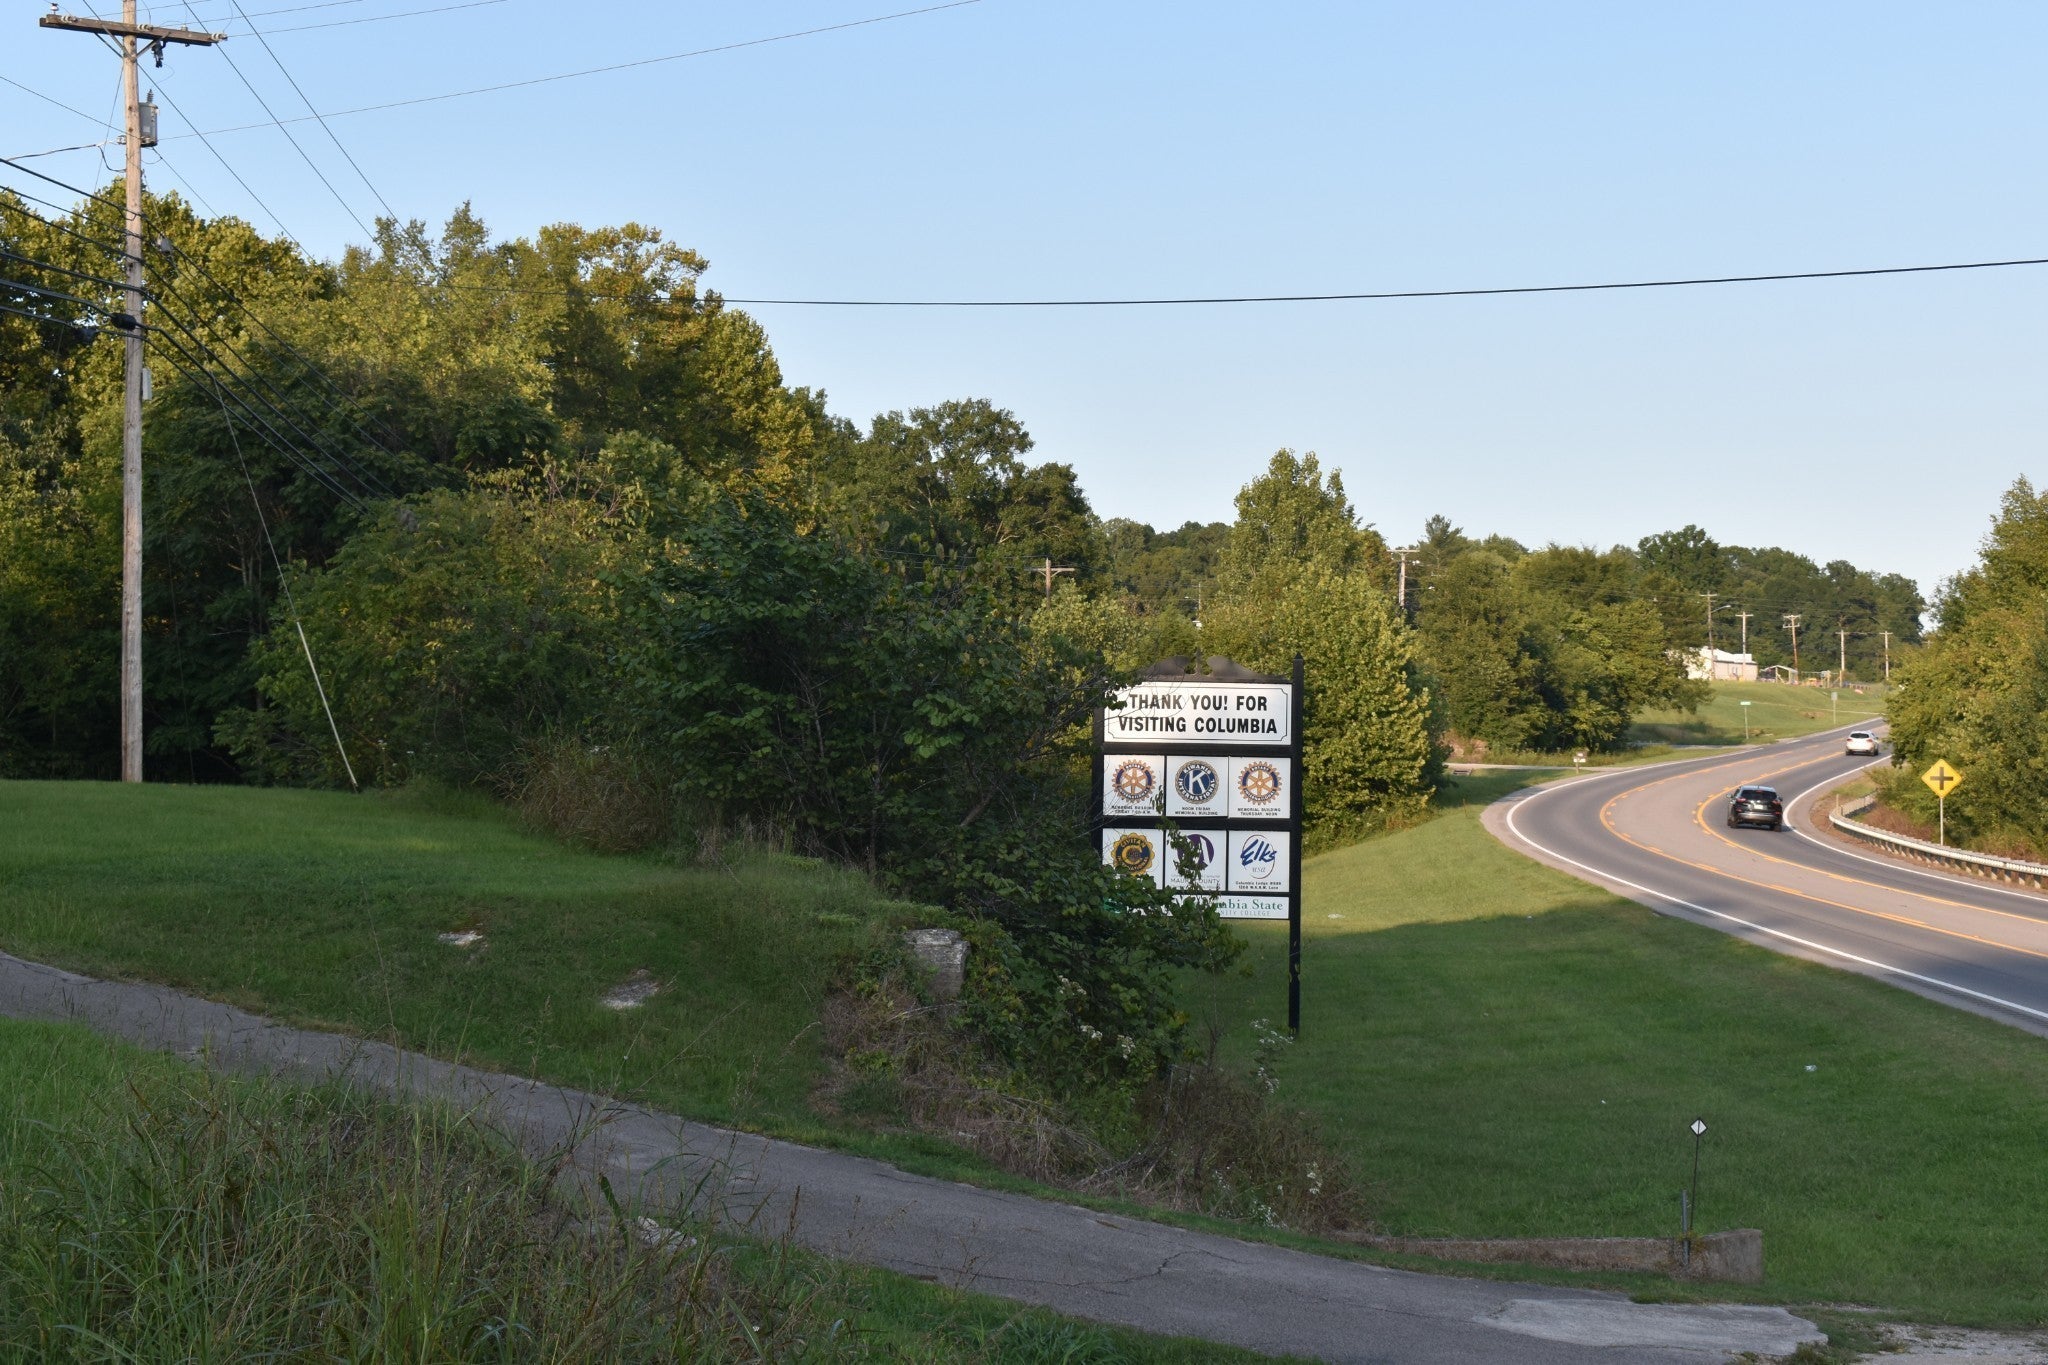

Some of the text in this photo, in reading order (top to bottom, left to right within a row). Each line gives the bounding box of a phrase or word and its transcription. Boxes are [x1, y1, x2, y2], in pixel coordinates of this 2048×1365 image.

[1129, 694, 1268, 711] THANK YOU! FOR
[1118, 715, 1278, 734] VISITING COLUMBIA
[1183, 764, 1212, 774] KIWANIS
[1178, 778, 1216, 801] INTERNATIONAL
[1188, 769, 1206, 795] K
[1240, 839, 1277, 866] Elks
[1216, 898, 1284, 911] mbia State
